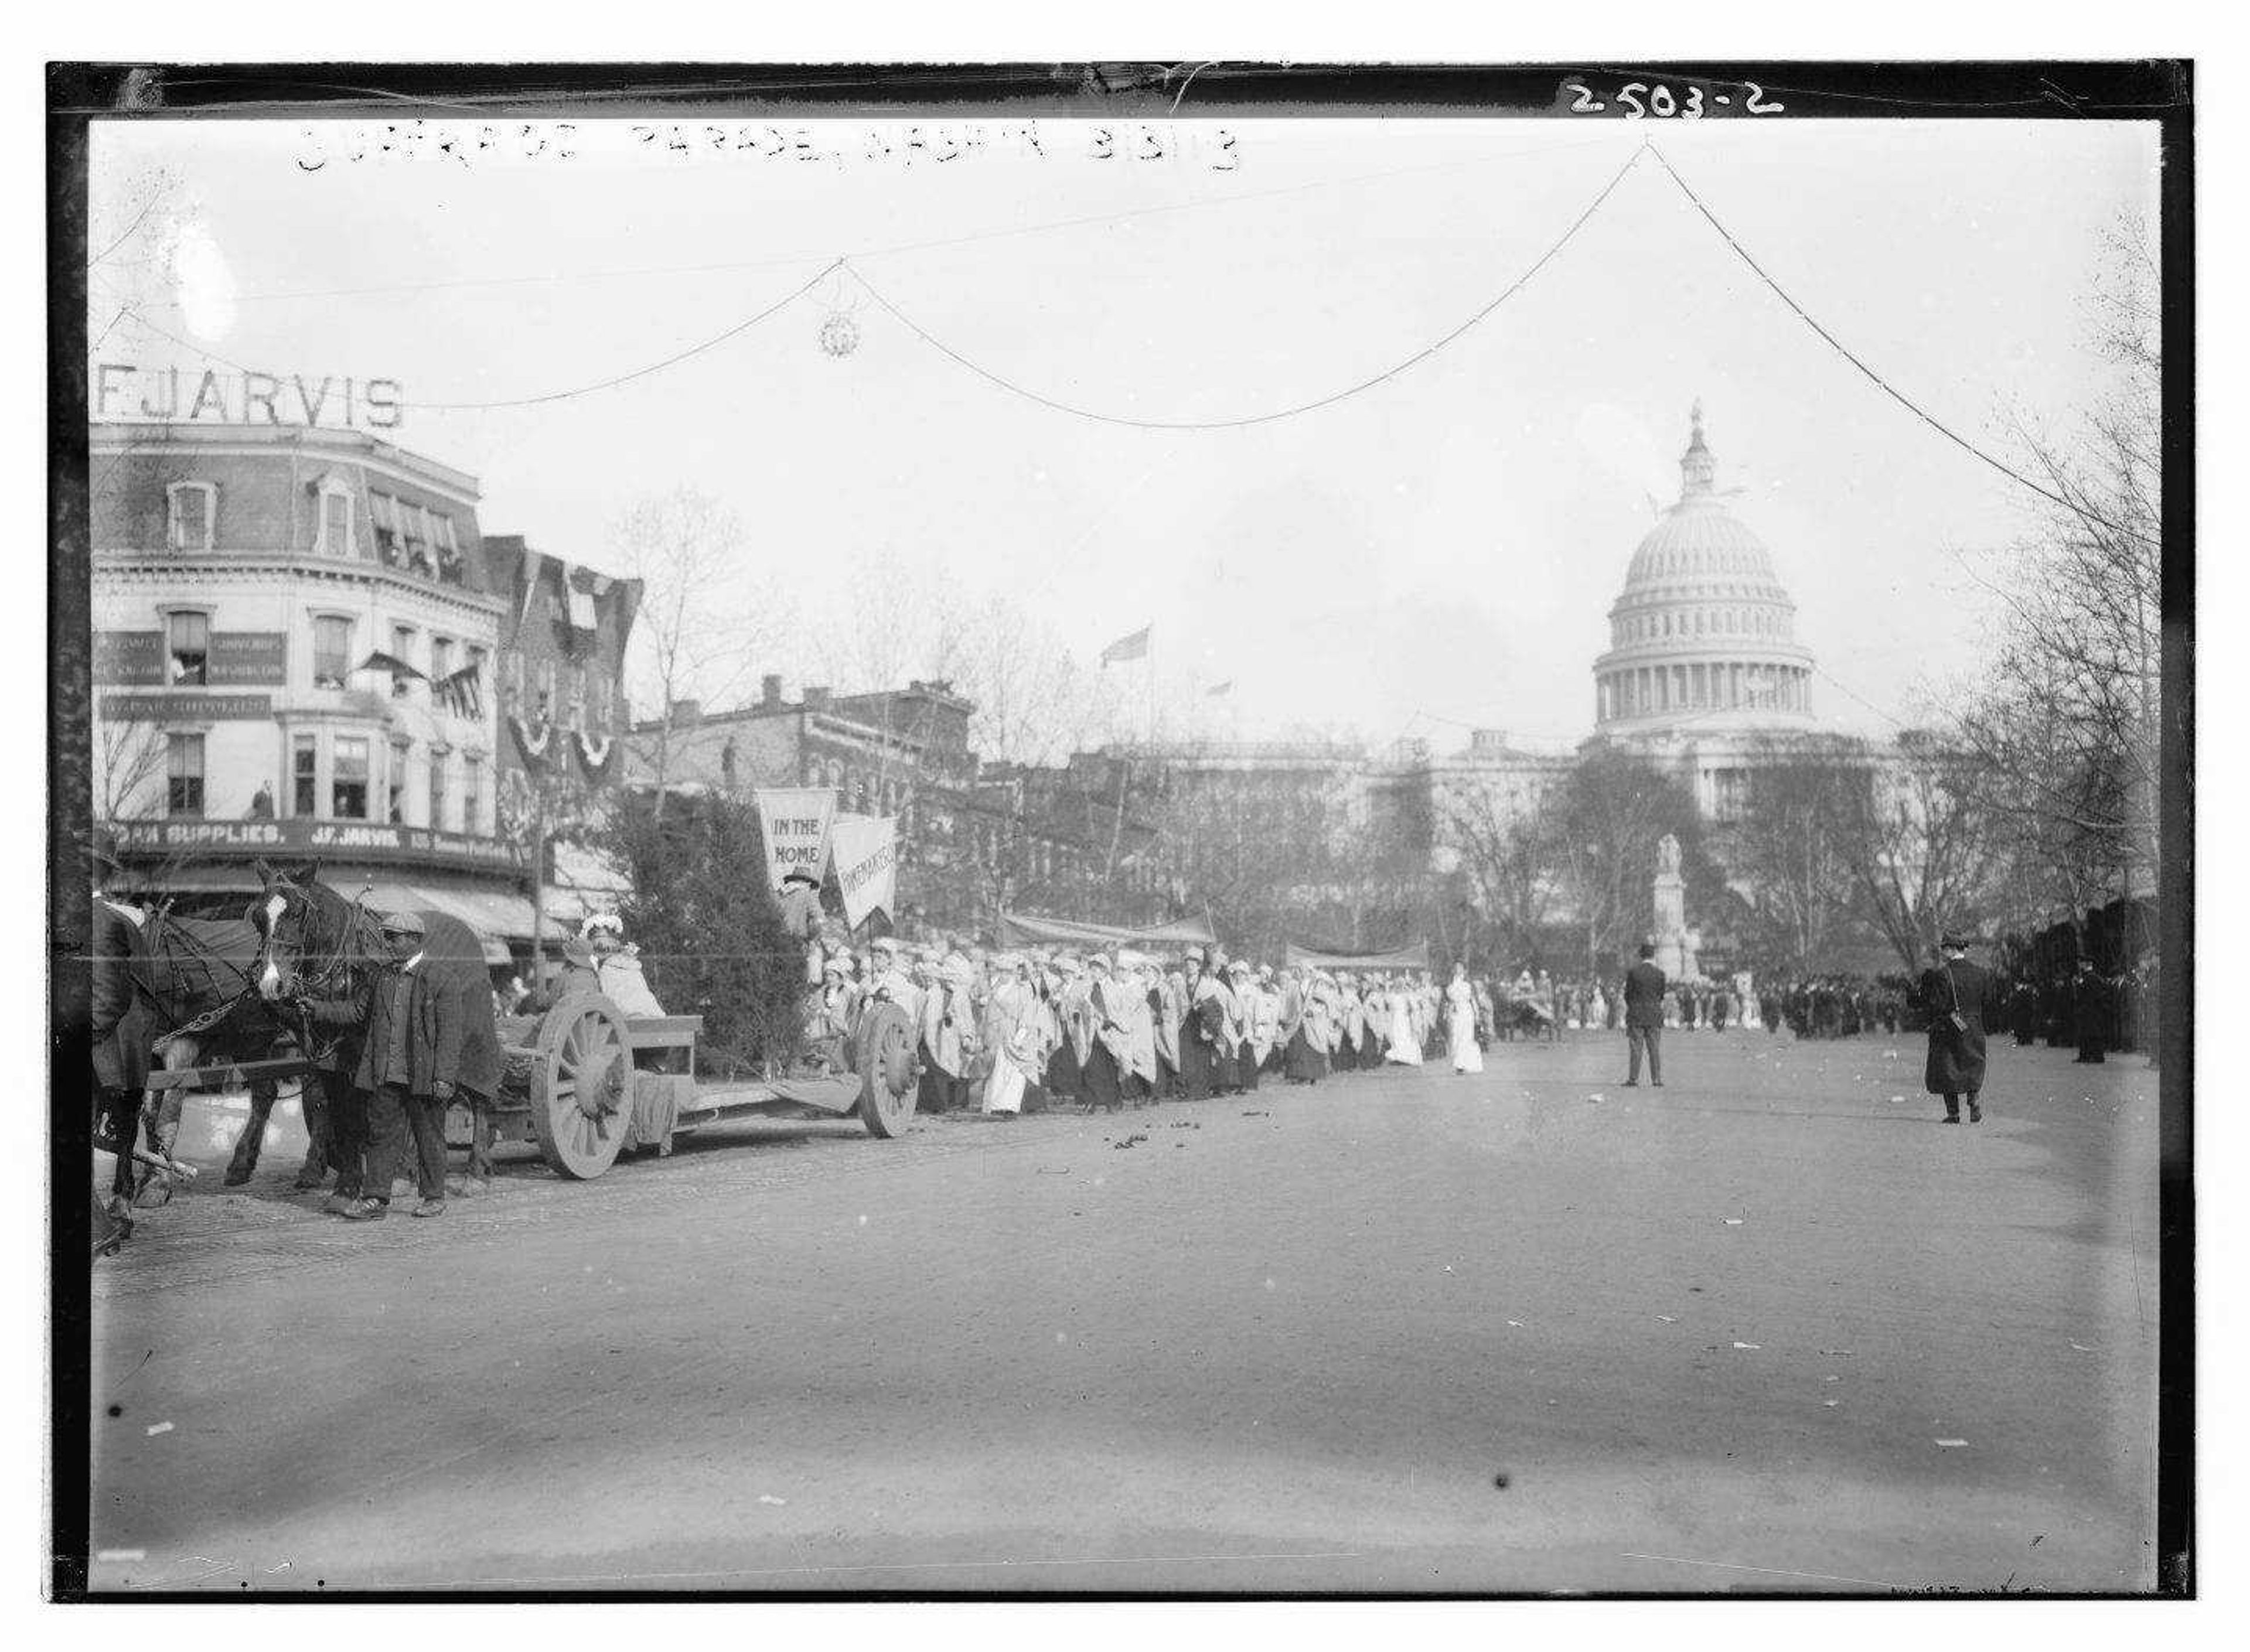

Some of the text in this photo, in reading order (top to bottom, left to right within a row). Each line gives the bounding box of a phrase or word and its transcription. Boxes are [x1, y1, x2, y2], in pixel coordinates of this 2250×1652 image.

[141, 366, 402, 429] JARVIS
[774, 819, 819, 835] IN THE
[775, 847, 819, 863] HOME
